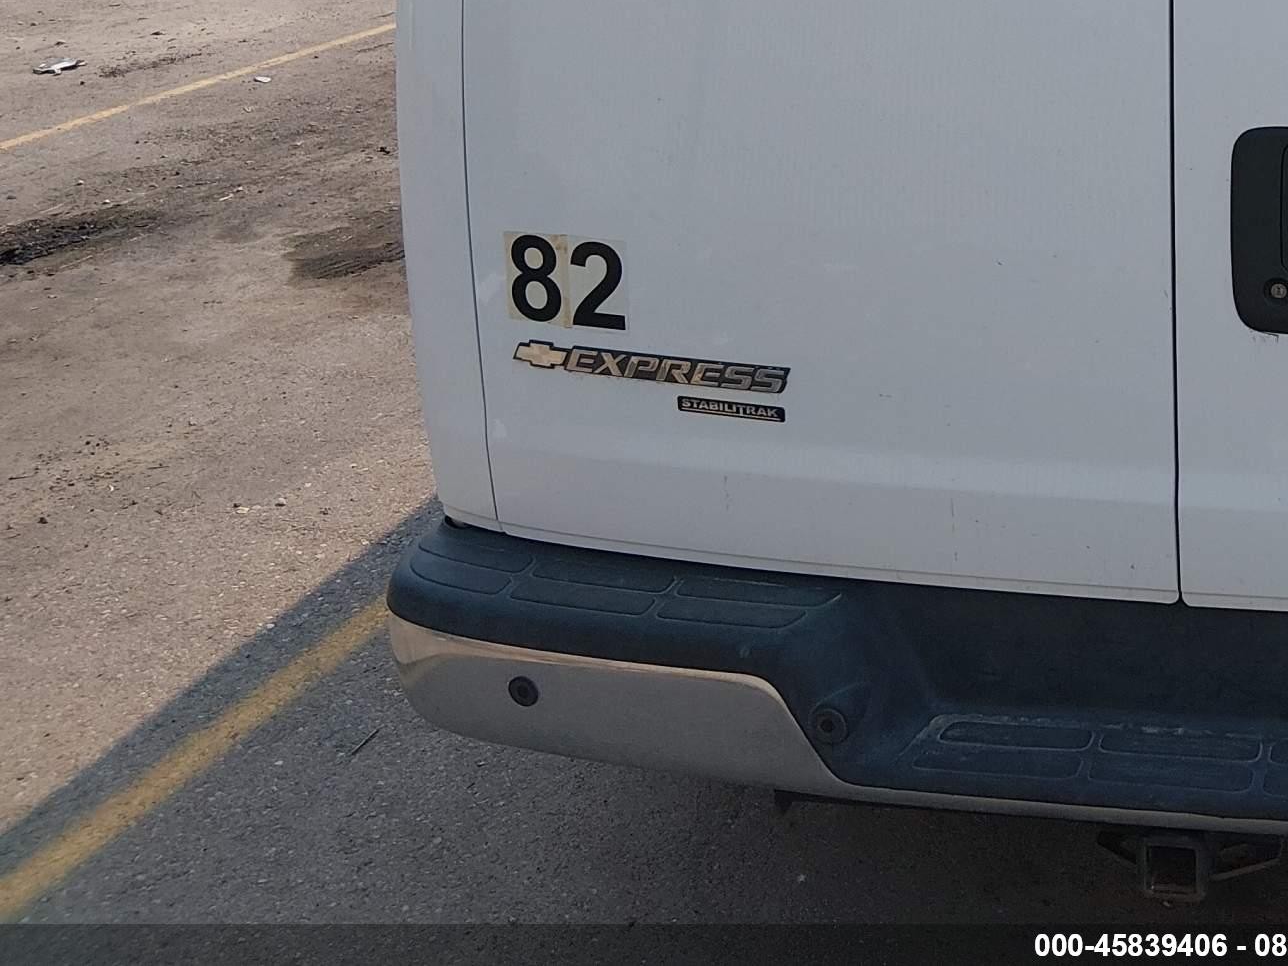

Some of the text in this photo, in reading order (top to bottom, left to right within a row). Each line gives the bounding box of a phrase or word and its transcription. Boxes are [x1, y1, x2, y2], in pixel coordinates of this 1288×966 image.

[510, 234, 626, 330] 82
[566, 348, 787, 393] EXPRESS
[681, 398, 778, 417] STABILITRAK
